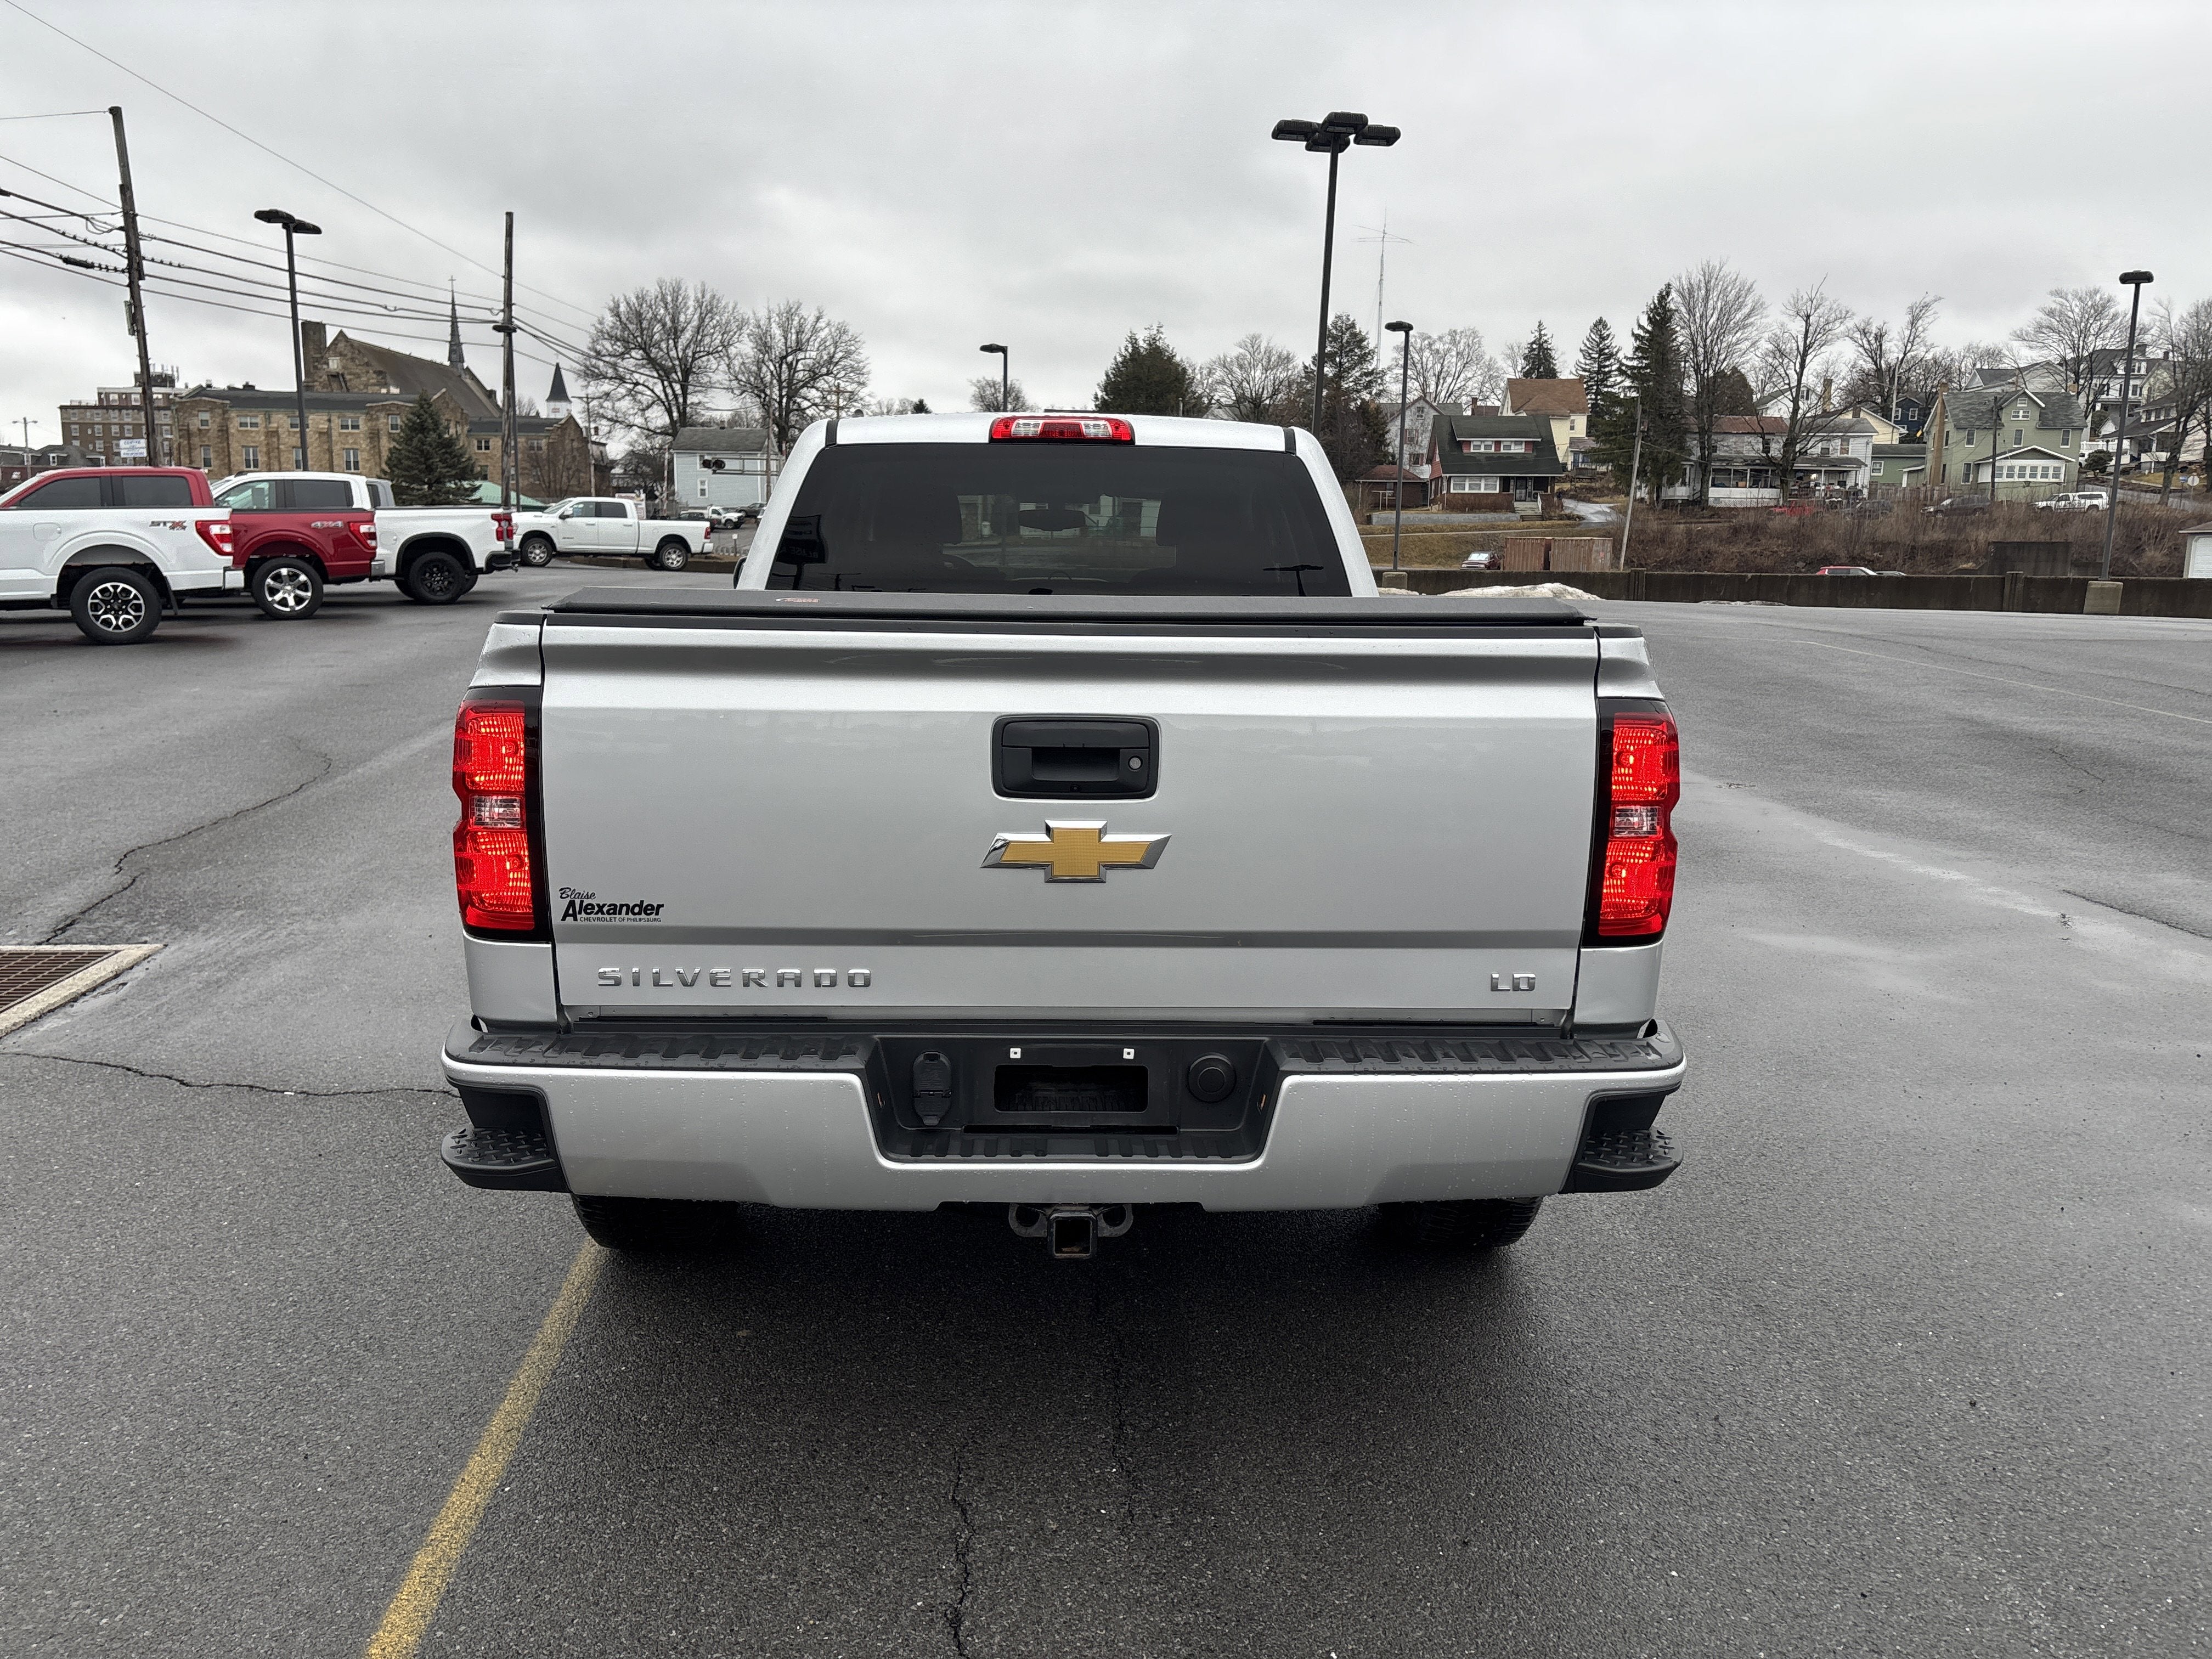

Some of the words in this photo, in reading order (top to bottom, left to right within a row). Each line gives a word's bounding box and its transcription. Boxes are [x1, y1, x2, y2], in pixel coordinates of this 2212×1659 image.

[558, 887, 596, 900] Blaise
[561, 900, 664, 922] Alexander
[597, 967, 871, 988] SILVERADO
[1491, 973, 1536, 991] LD
